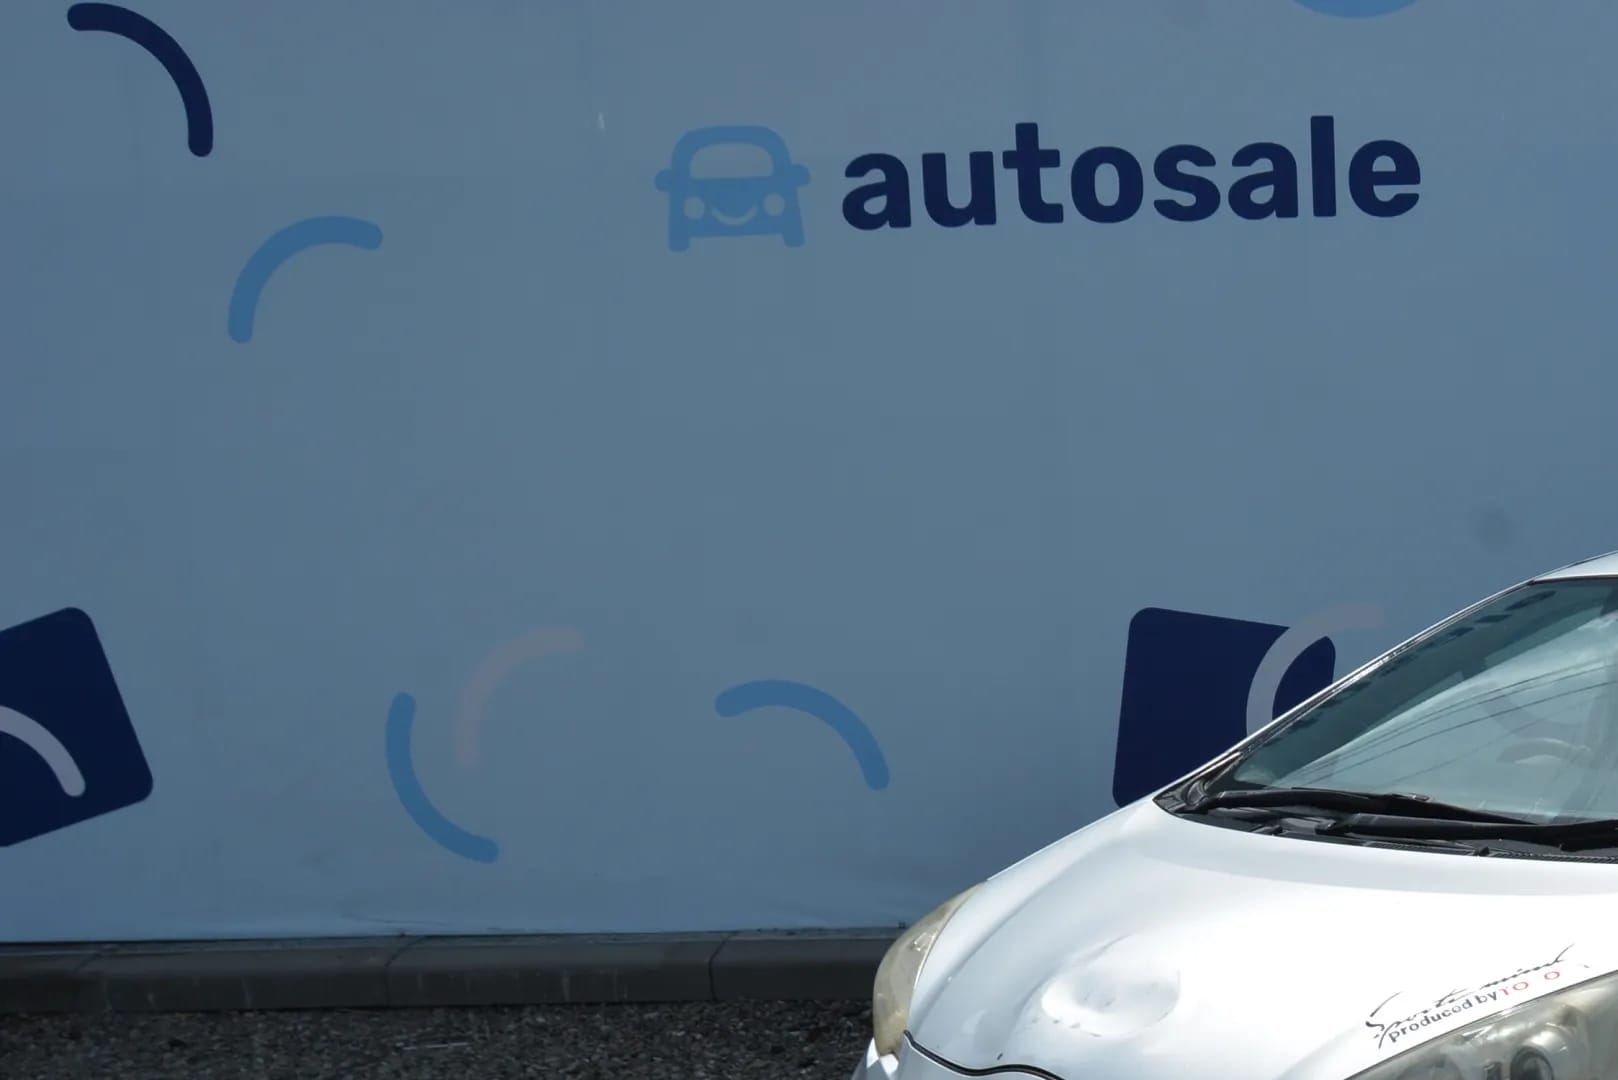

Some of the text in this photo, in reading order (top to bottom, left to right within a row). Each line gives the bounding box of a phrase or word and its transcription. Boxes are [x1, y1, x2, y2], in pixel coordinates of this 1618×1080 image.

[842, 115, 1422, 231] autosale
[1387, 998, 1474, 1044] produced
[1476, 989, 1498, 1006] by
